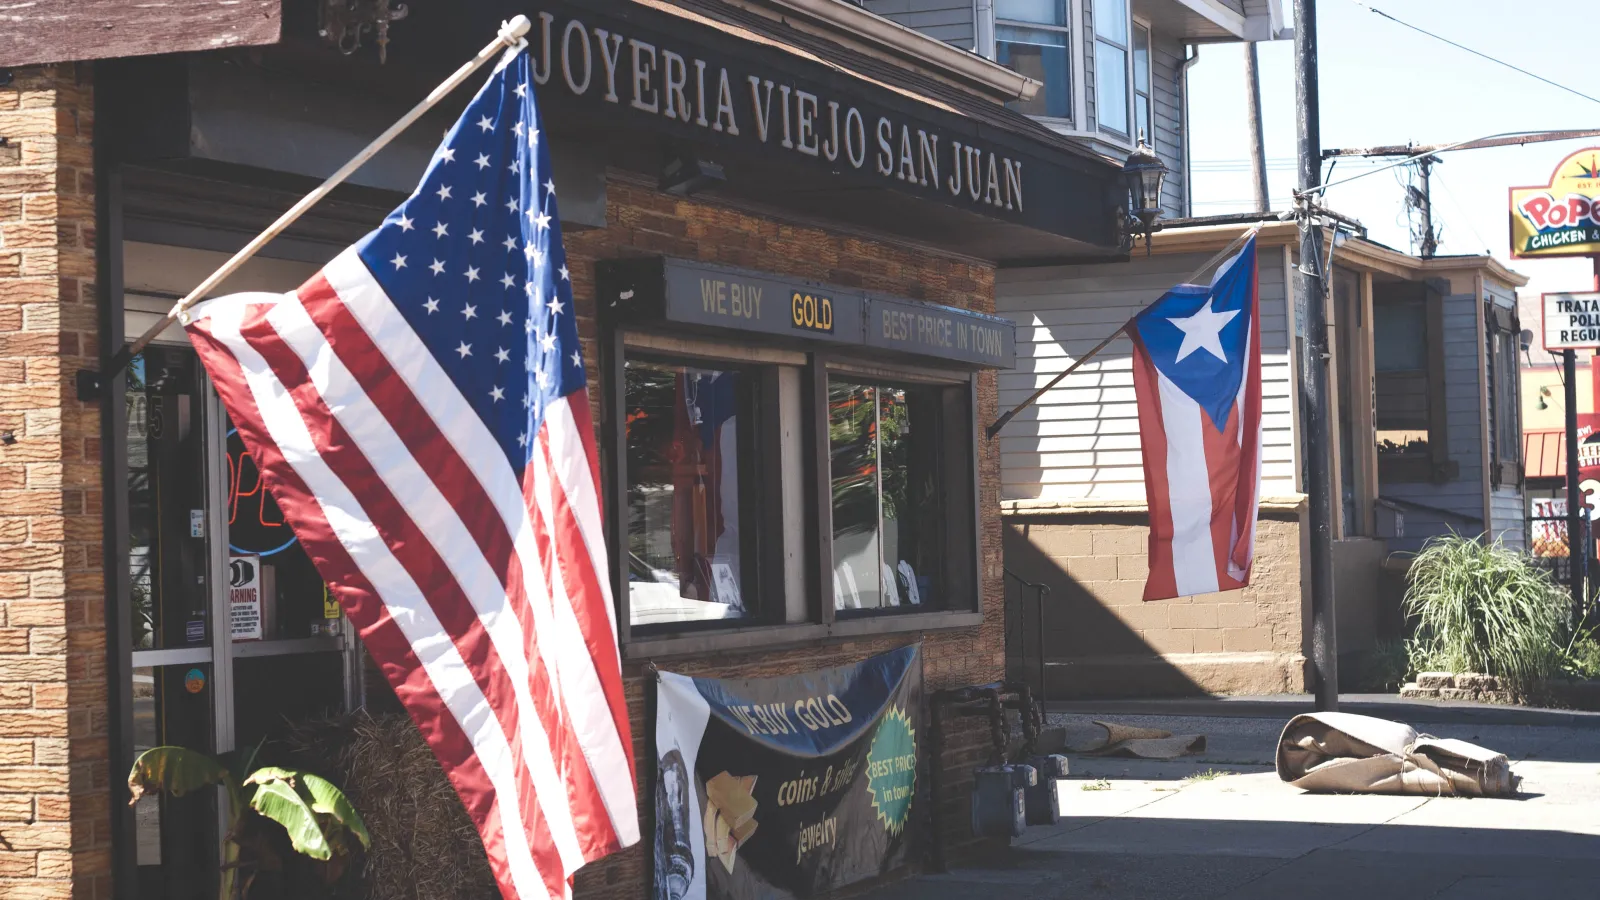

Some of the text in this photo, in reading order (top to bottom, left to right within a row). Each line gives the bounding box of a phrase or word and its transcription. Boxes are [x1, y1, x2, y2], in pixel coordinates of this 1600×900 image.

[531, 11, 1023, 213] JOYERIA VIEJO SAN JUAN
[1531, 230, 1587, 249] CHICKEN
[700, 278, 833, 331] WE BUY GOLD
[1556, 299, 1600, 313] TRATA
[882, 309, 1003, 357] BEST PRICE IN TOWN
[230, 587, 257, 603] ARNING
[753, 702, 798, 735] BUY
[794, 694, 853, 731] GOLD
[777, 769, 819, 807] coins
[820, 765, 833, 797] &
[871, 758, 893, 778] BEST
[883, 785, 910, 803] in town
[797, 811, 837, 866] jewelry
